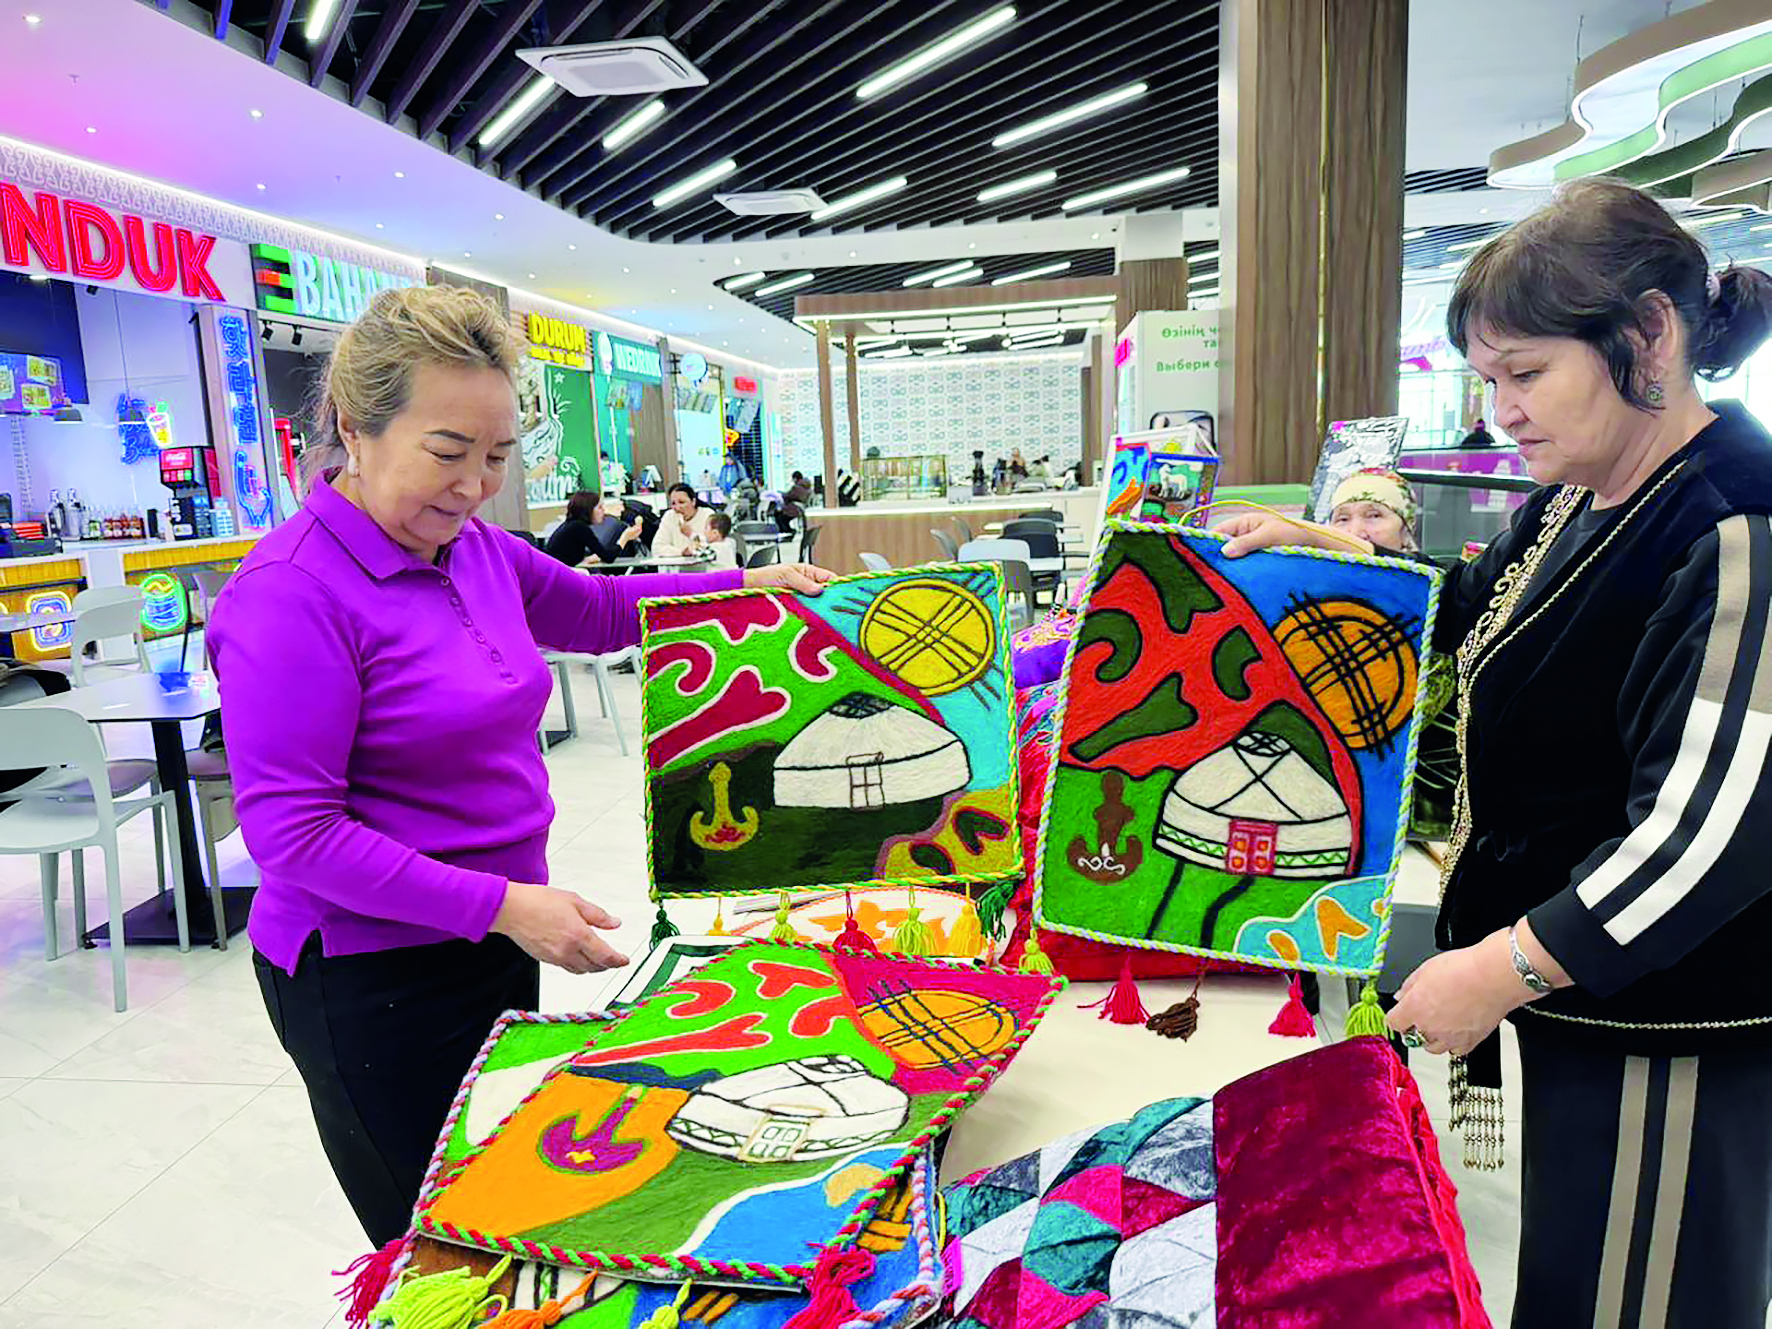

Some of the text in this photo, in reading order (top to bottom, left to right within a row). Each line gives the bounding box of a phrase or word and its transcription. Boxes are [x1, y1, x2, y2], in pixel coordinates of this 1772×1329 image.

[0, 182, 226, 302] NDUK
[530, 313, 586, 355] DURUM
[1156, 359, 1210, 371] Выбери
